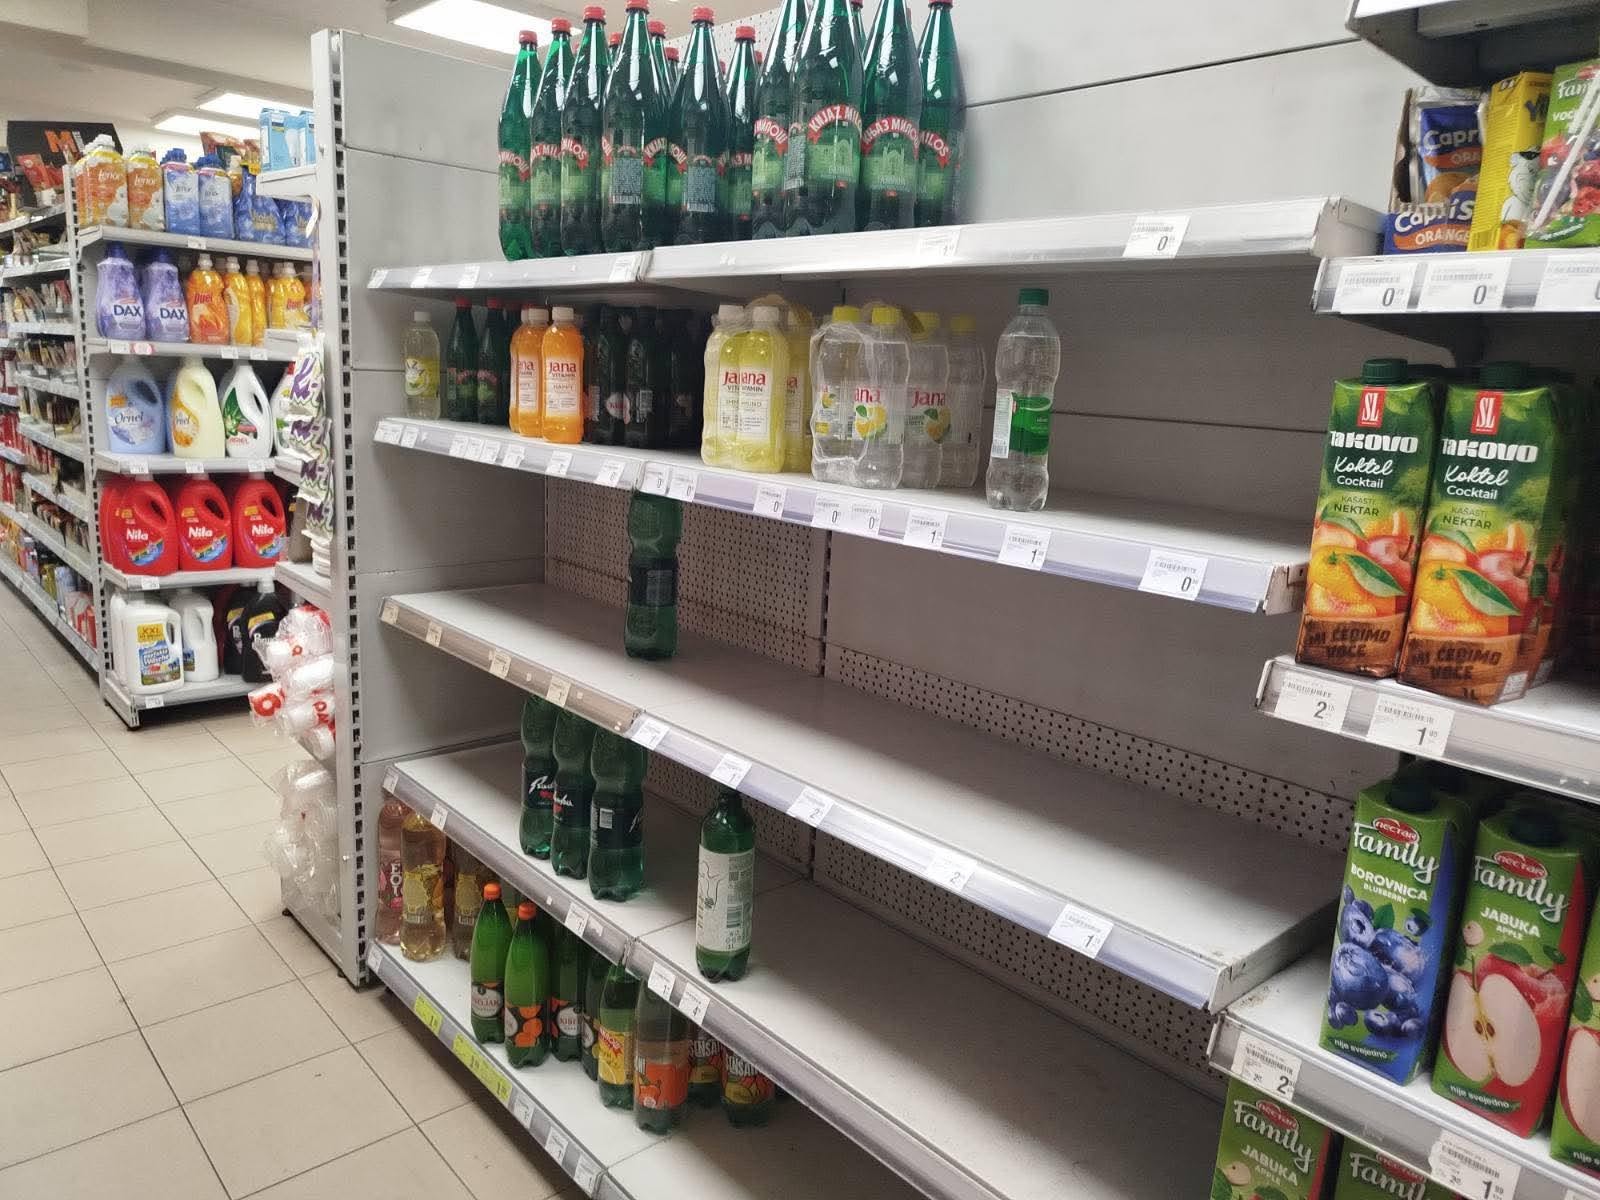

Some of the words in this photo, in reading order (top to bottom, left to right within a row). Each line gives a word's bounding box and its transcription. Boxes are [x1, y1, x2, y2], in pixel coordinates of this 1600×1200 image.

[113, 304, 142, 317] DAX
[160, 307, 186, 320] DAX
[1362, 392, 1380, 422] SL
[1476, 397, 1497, 429] SL
[1333, 455, 1394, 476] Koktel
[1443, 464, 1510, 486] Koktel
[1336, 475, 1384, 489] Cocktail
[1446, 485, 1499, 500] Cocktail
[1334, 503, 1380, 517] NEKTAR
[1442, 515, 1492, 530] NEKTAR
[1353, 822, 1441, 885] Family
[1350, 862, 1428, 902] BOROVNICA
[1474, 855, 1570, 923] Family
[1363, 882, 1407, 904] BLUEBERRY
[1480, 907, 1541, 938] JABUKA
[1496, 925, 1524, 941] APPLE
[1334, 1038, 1349, 1050] nije
[1449, 1085, 1467, 1098] nije
[1233, 1099, 1315, 1174] Family
[1241, 1144, 1299, 1187] JABUKA
